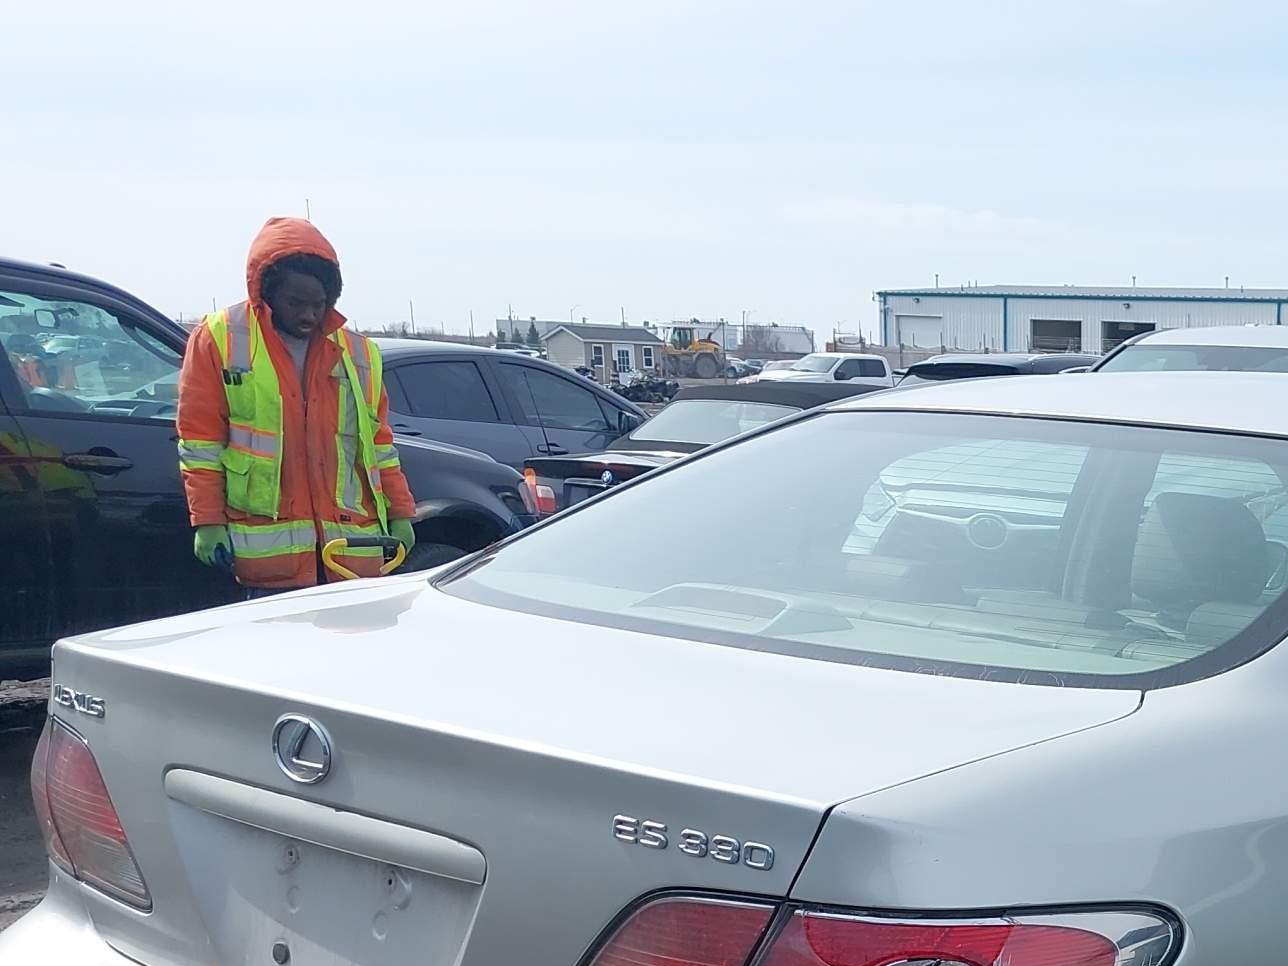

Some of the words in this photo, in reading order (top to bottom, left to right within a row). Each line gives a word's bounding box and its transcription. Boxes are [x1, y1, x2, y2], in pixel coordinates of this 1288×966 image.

[54, 684, 105, 718] LEXUS
[613, 814, 669, 850] ES
[678, 828, 775, 871] 330
